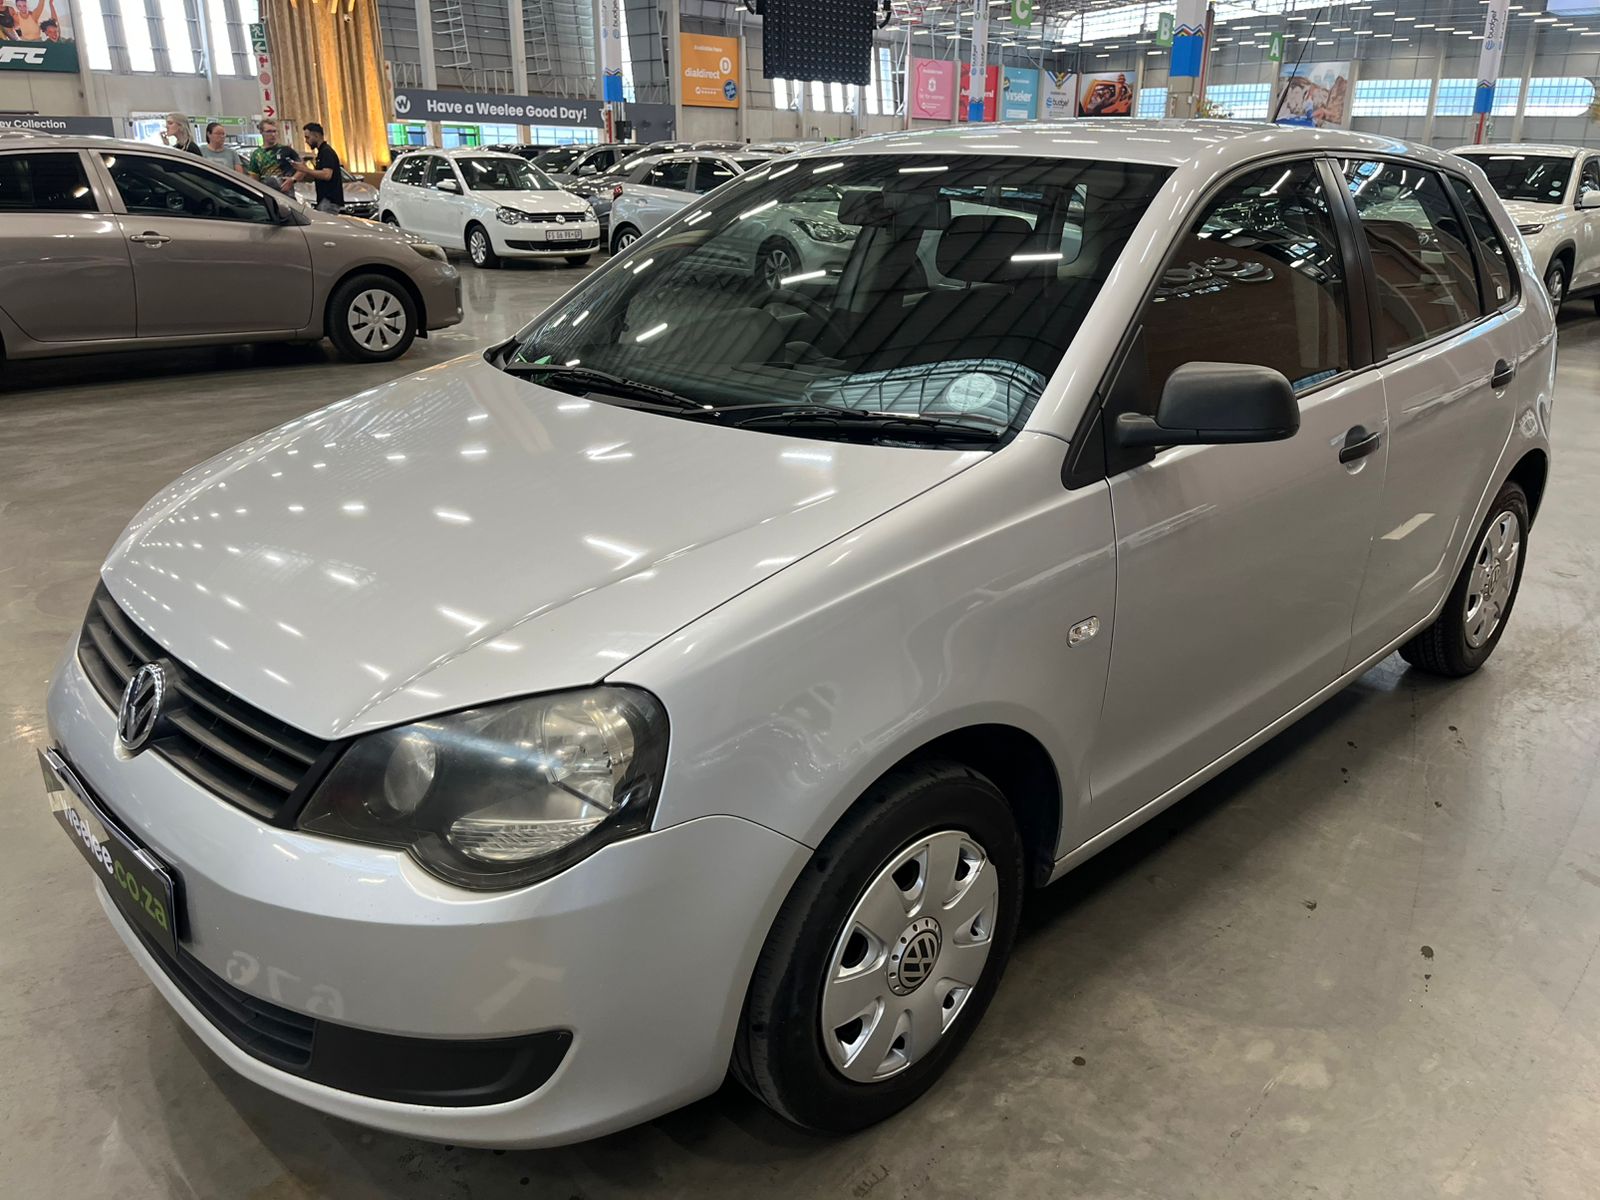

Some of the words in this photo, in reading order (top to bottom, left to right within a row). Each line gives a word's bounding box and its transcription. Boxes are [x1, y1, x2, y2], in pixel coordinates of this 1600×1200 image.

[1016, 0, 1029, 19] C
[1160, 17, 1170, 40] B
[0, 46, 47, 64] FC
[1270, 37, 1279, 57] A
[427, 99, 462, 114] Have
[464, 103, 474, 114] a
[476, 102, 524, 117] Weelee
[526, 105, 557, 118] Good
[559, 107, 588, 123] Day!
[14, 119, 66, 129] Collection
